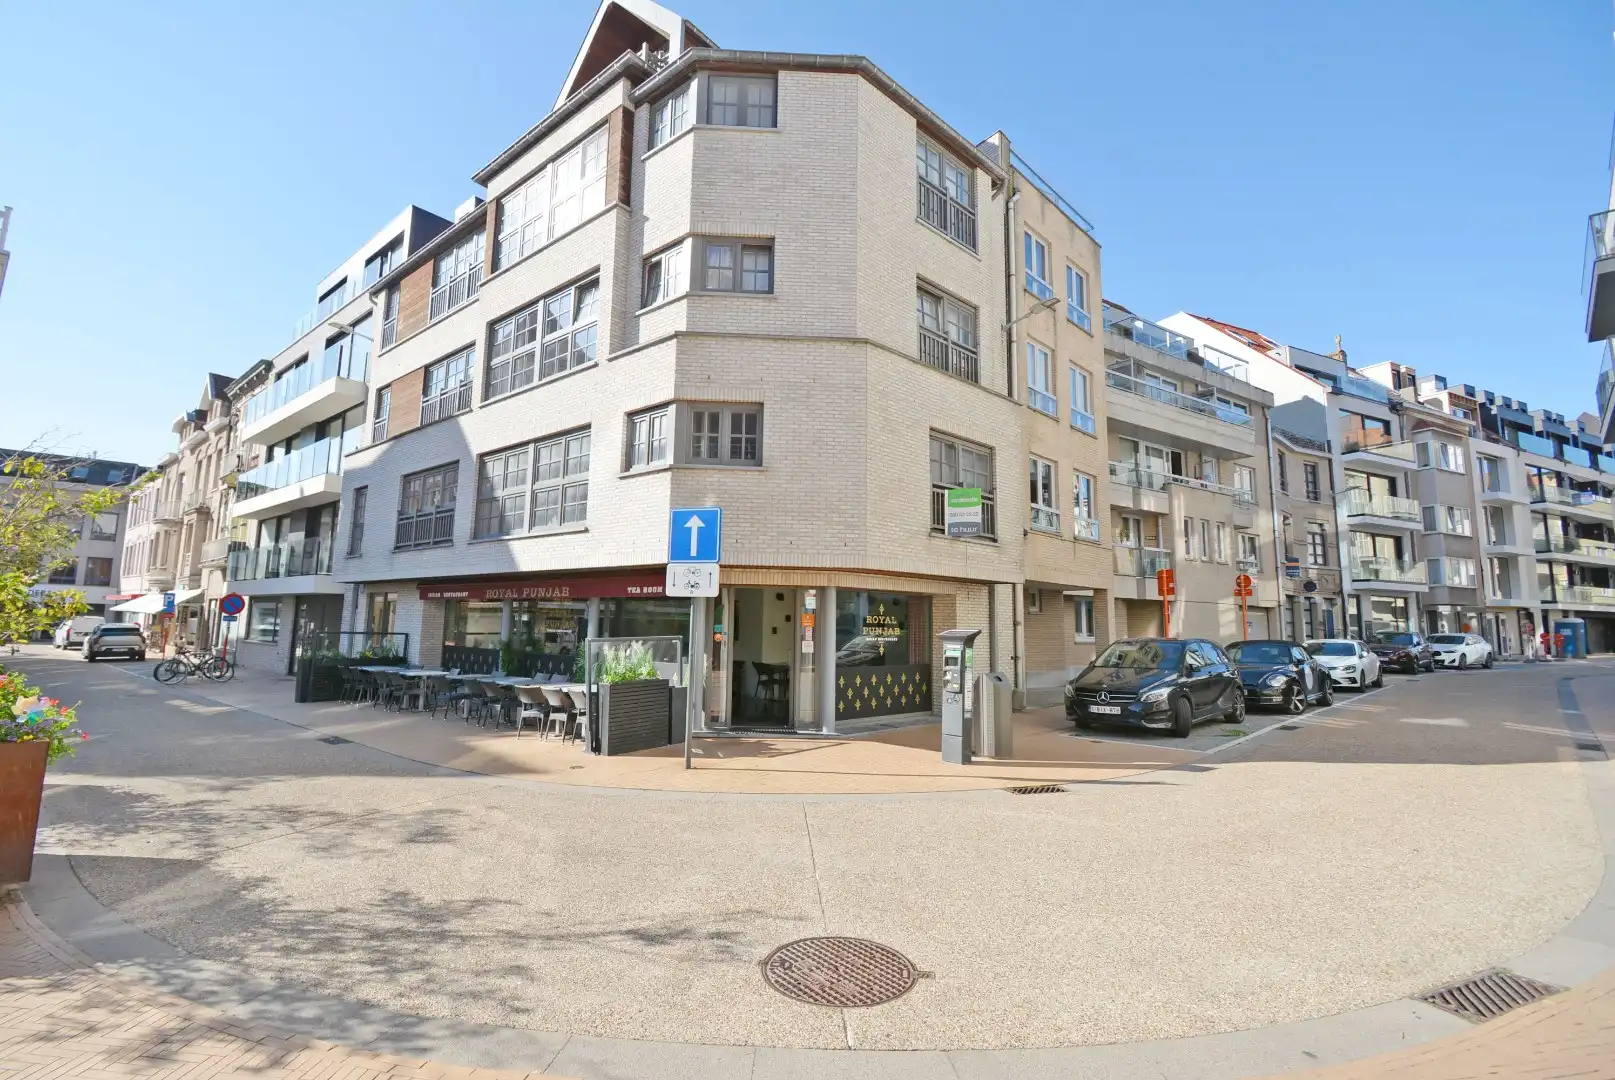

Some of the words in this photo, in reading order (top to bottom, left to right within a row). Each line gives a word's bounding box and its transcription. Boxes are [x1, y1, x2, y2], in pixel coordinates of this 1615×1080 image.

[486, 589, 518, 598] ROYAL
[523, 587, 570, 597] PUNJAB
[627, 586, 641, 594] TEA
[643, 586, 663, 594] ROOM
[164, 595, 174, 606] P
[866, 615, 897, 624] ROYAL
[862, 626, 901, 635] PUNJAB
